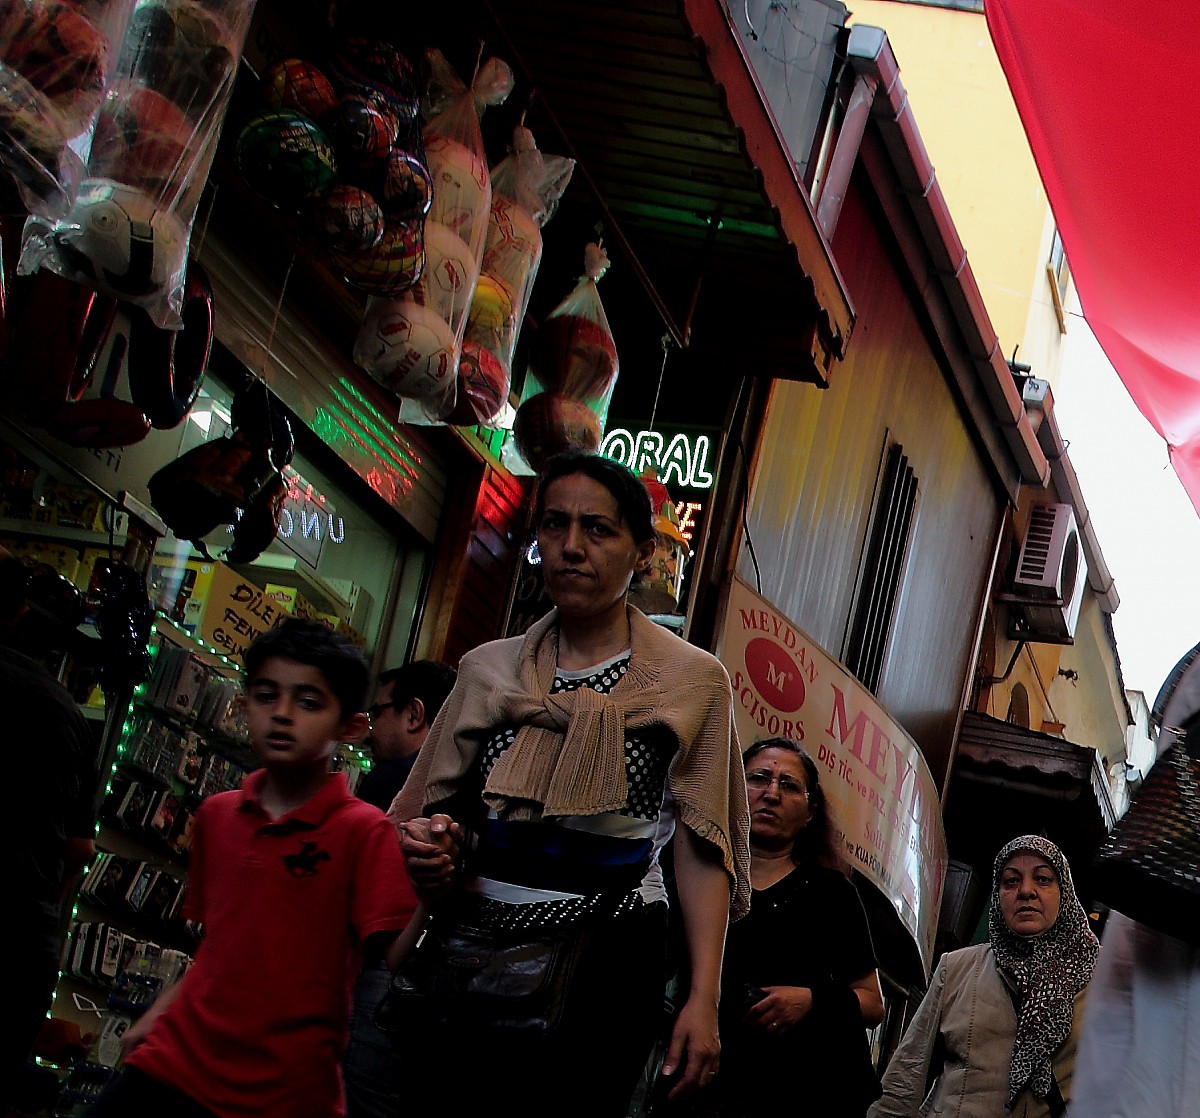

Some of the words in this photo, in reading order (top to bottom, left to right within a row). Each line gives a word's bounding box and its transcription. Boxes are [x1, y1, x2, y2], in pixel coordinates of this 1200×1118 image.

[740, 608, 819, 684] MEYDAN
[732, 672, 805, 741] SCISORS
[818, 744, 836, 773] DIŞ
[838, 759, 854, 786] TİC.
